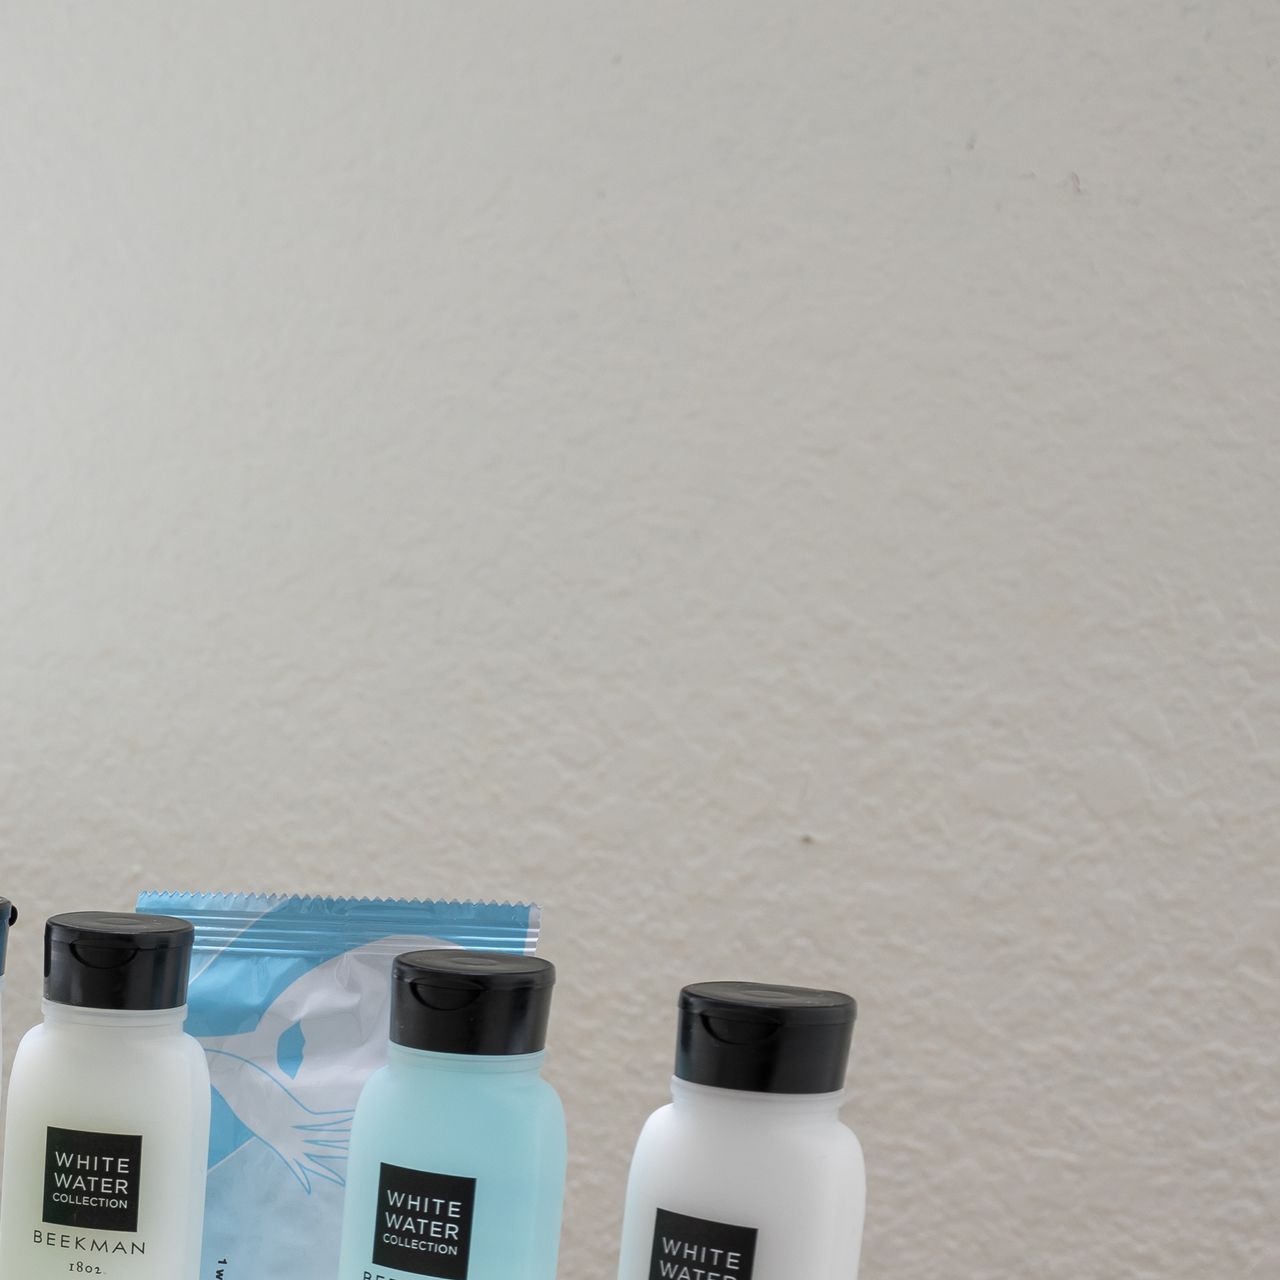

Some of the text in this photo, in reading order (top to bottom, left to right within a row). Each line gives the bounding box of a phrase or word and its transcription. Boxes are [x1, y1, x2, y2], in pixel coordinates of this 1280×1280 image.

[55, 1151, 130, 1174] WHITE
[54, 1172, 129, 1195] WATER
[52, 1192, 128, 1209] COLLECTION
[387, 1189, 462, 1218] WHITE
[385, 1211, 459, 1240] WATER
[33, 1229, 145, 1255] BEEKMAN
[383, 1233, 458, 1256] COLLECTION
[662, 1236, 741, 1270] WHITE
